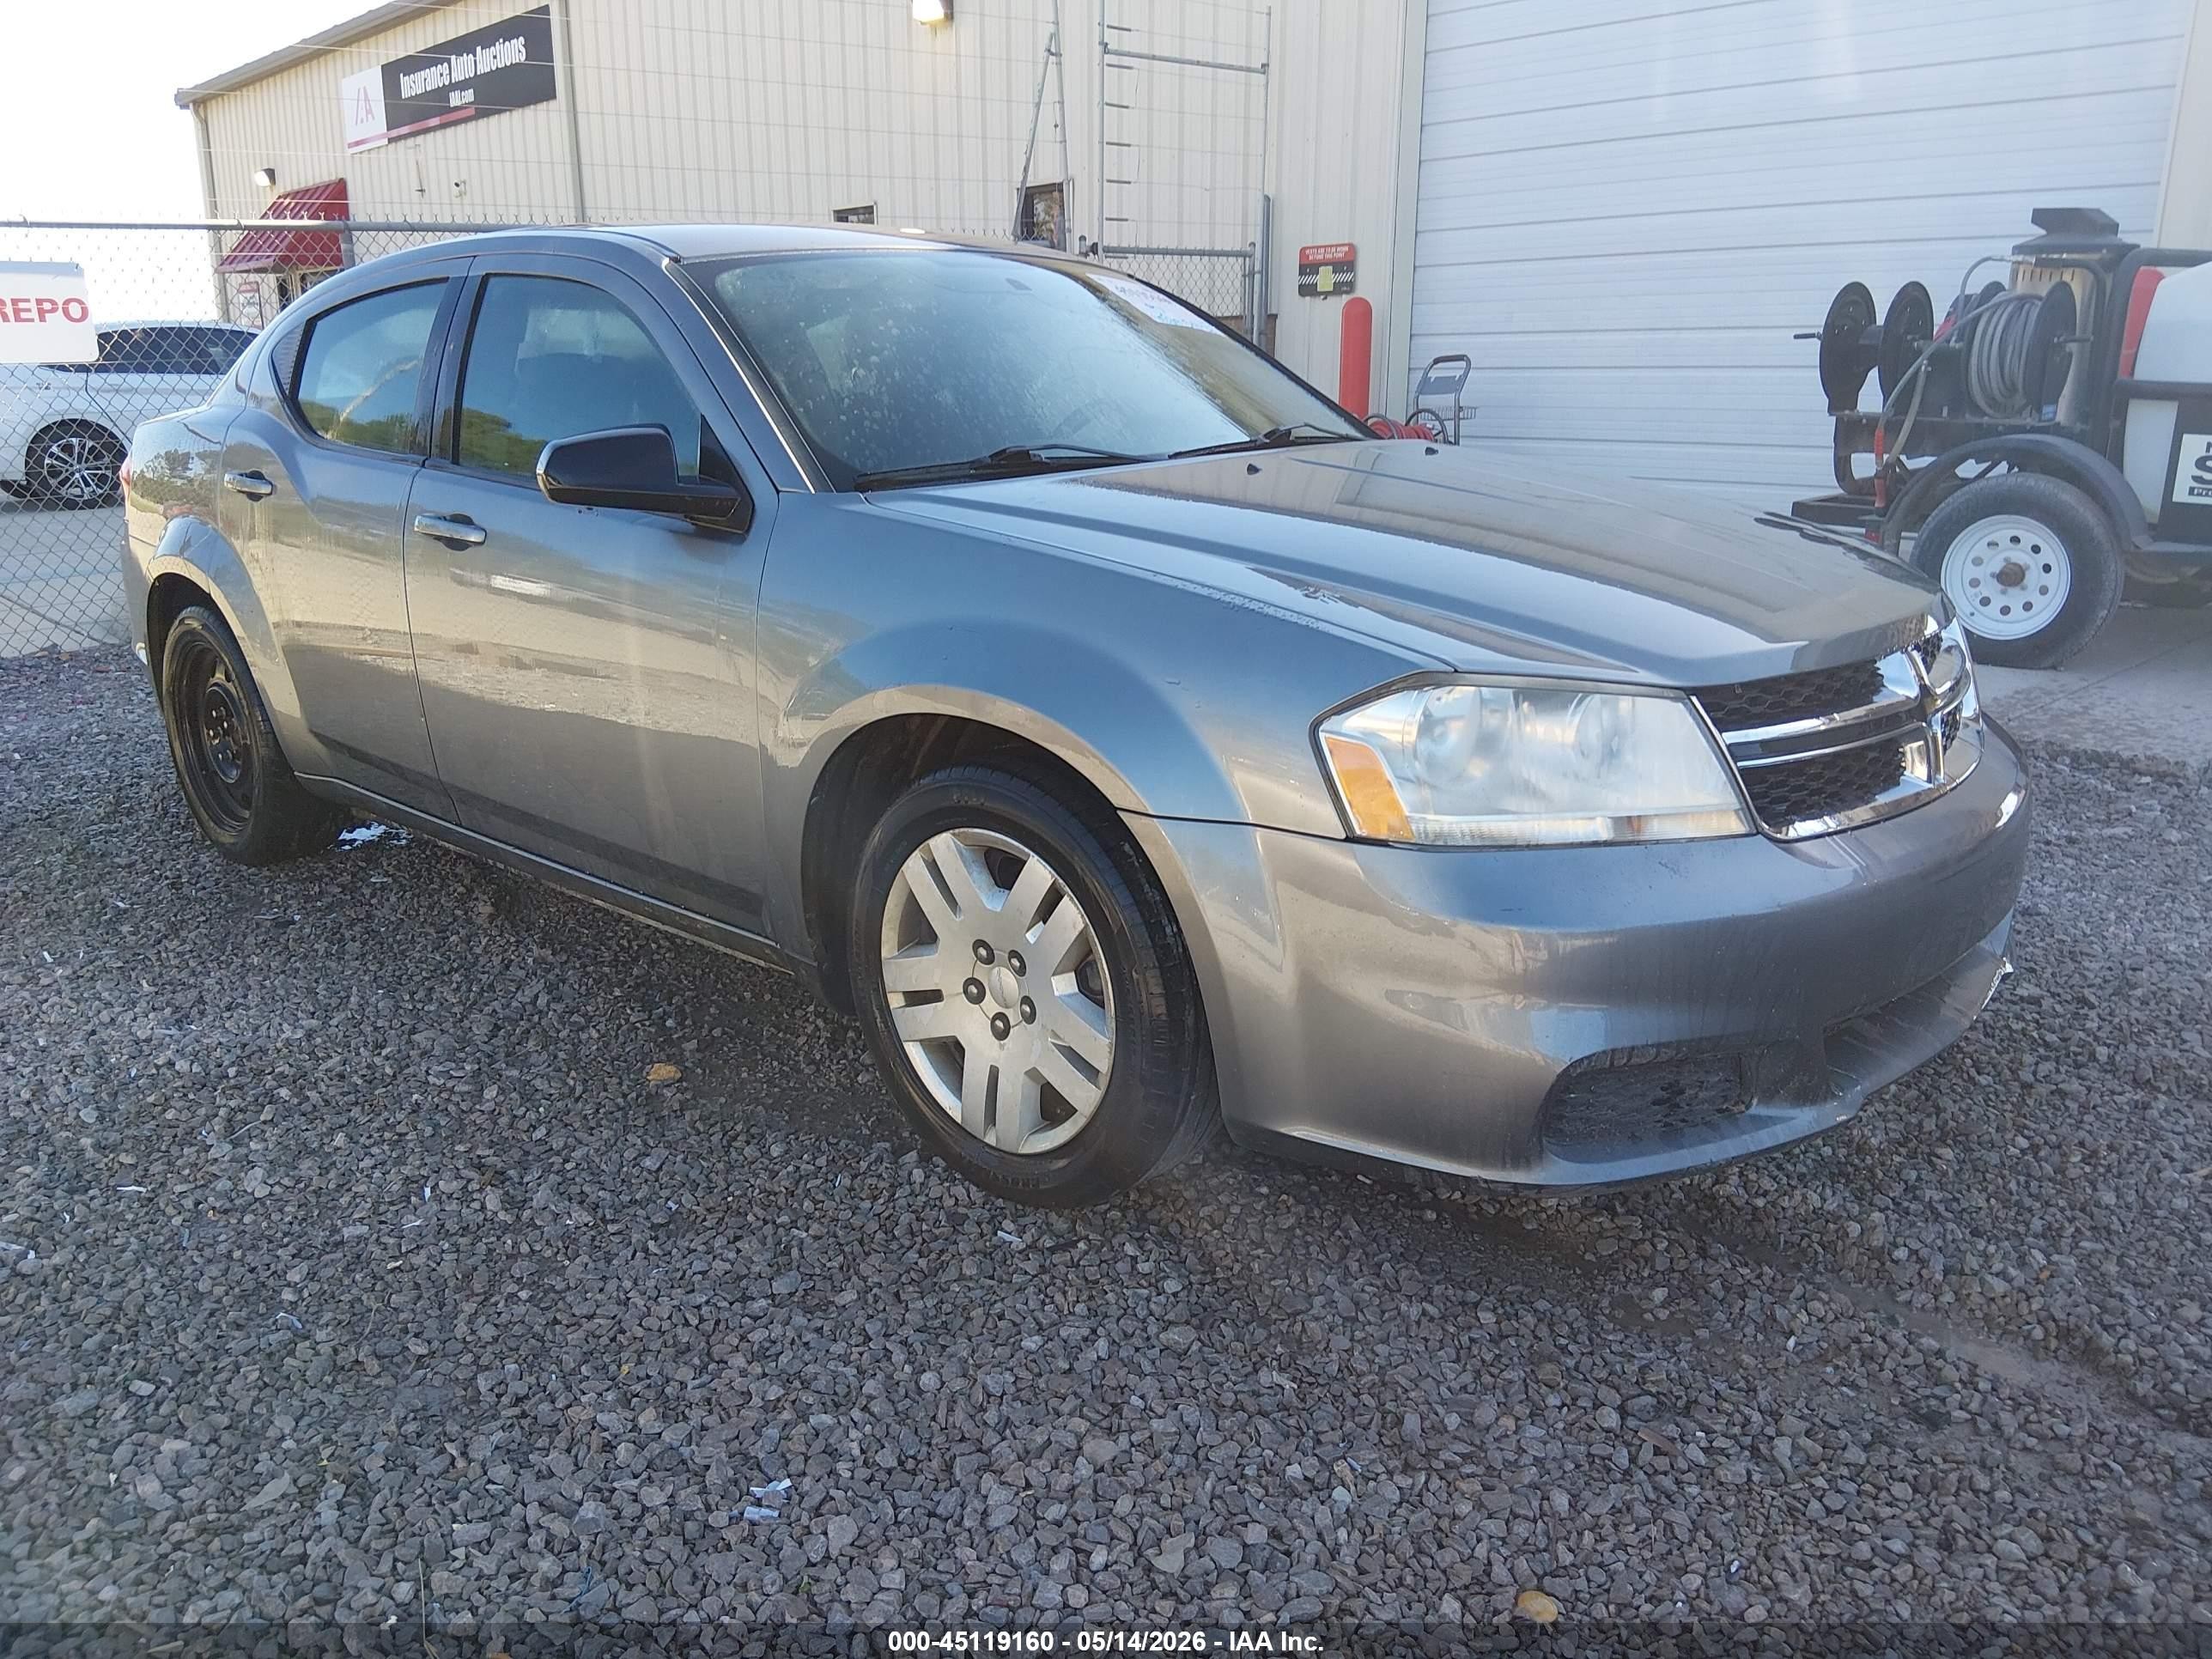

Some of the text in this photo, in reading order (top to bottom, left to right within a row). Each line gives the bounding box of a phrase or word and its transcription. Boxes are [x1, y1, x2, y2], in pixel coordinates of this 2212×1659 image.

[399, 36, 526, 99] Insurance Auto Auctions
[449, 88, 475, 107] IAAI.com
